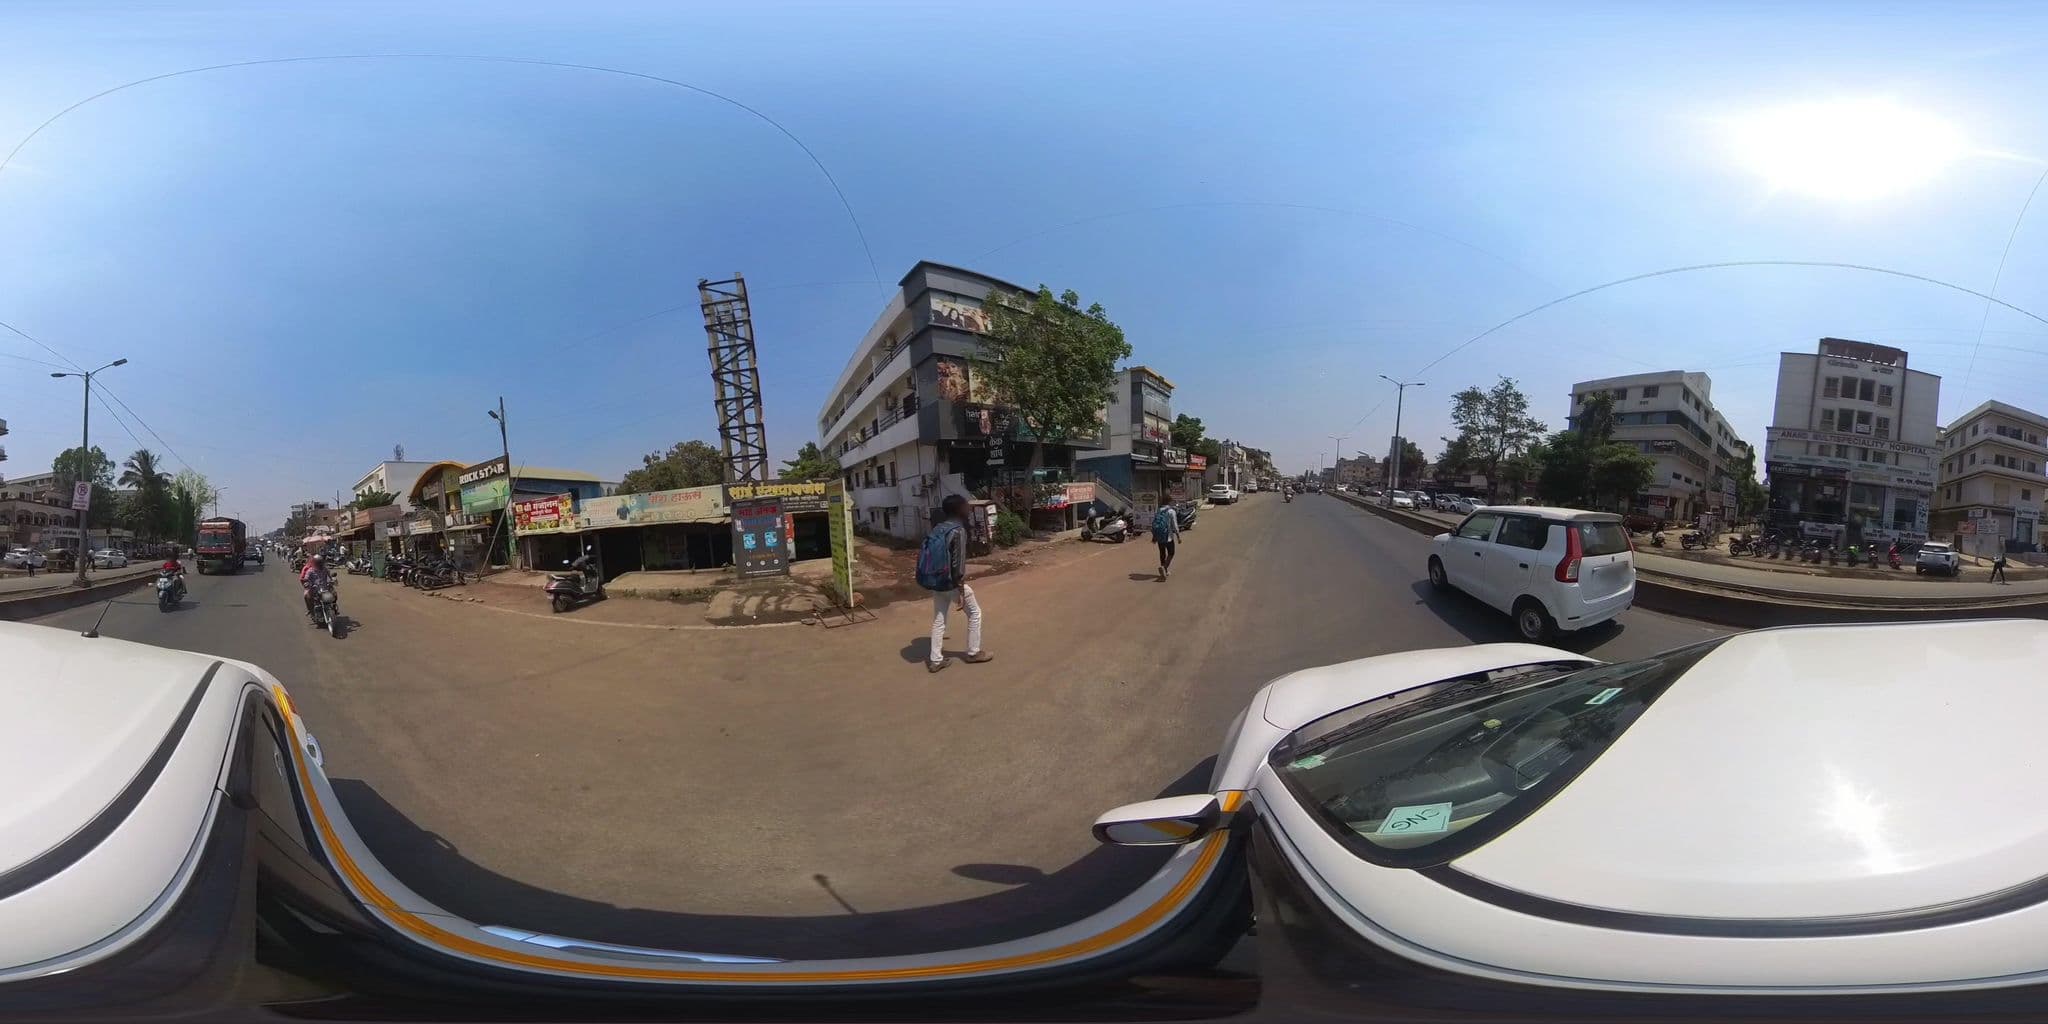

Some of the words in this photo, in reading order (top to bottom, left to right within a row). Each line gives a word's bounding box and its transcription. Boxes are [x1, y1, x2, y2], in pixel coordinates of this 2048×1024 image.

[1889, 442, 1928, 455] HOSPITAL
[458, 471, 479, 485] ROCK
[478, 463, 505, 479] STAR
[1391, 808, 1440, 830] CNG
